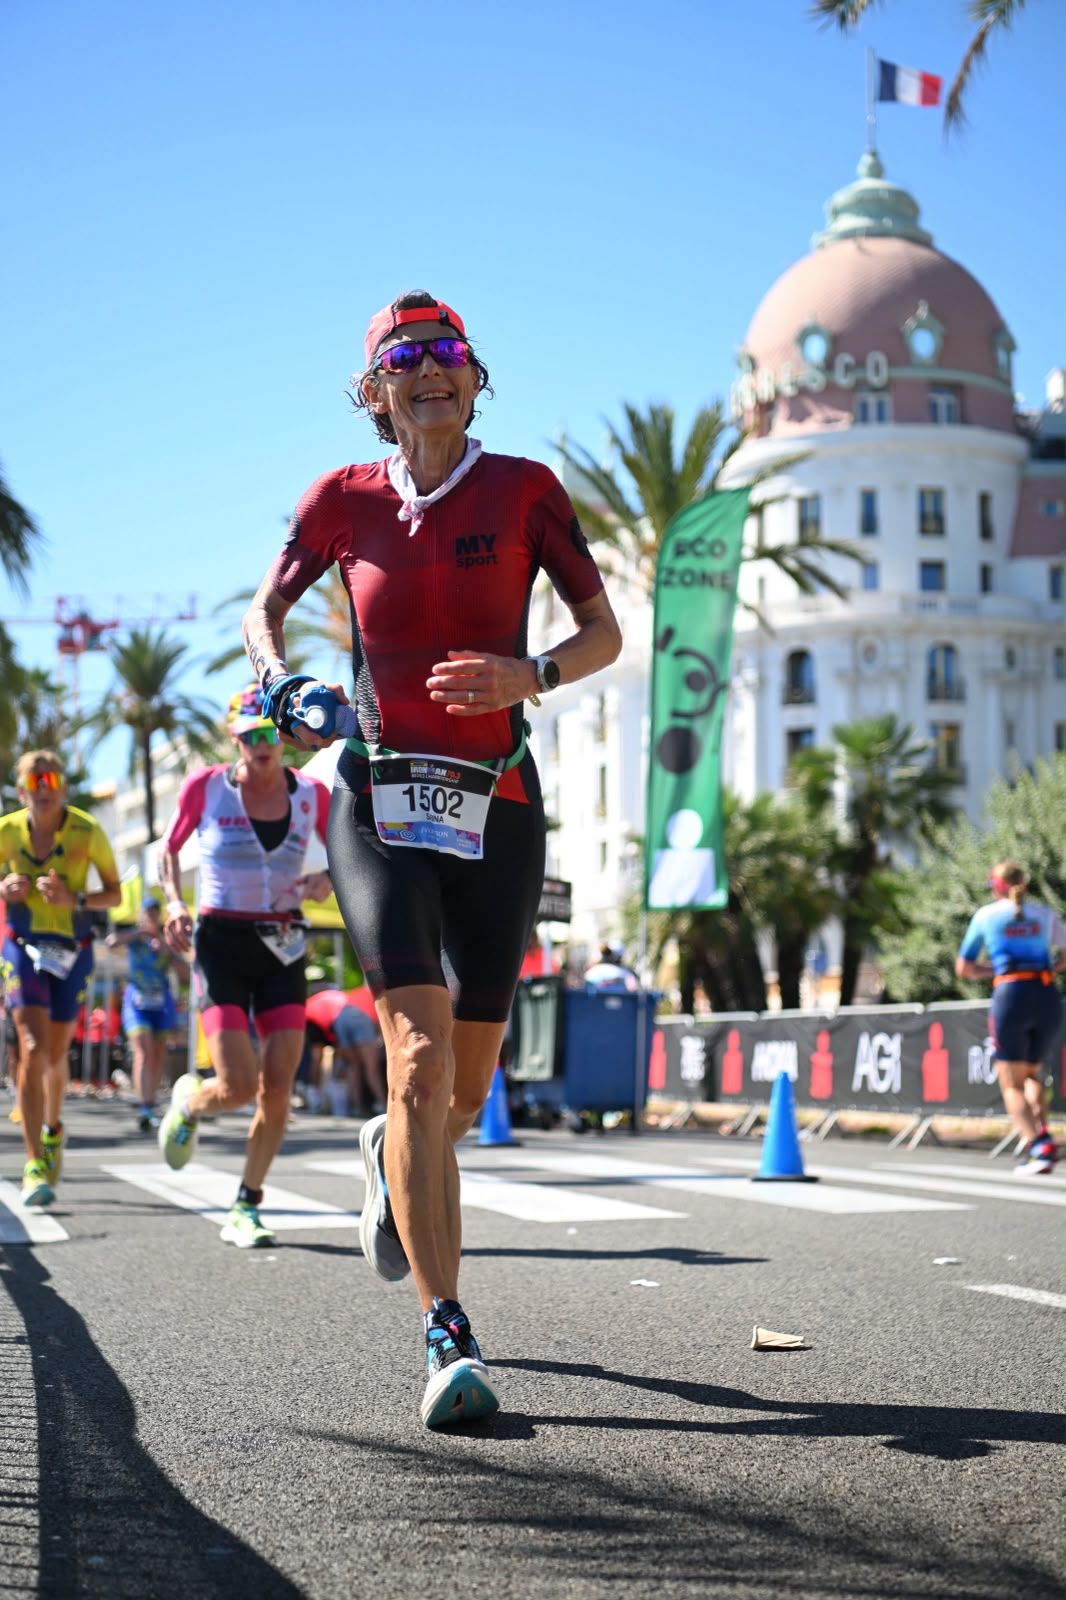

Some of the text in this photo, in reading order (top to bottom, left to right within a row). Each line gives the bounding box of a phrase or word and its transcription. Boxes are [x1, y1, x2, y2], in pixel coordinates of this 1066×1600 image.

[456, 534, 497, 555] MY
[675, 537, 727, 560] ECO
[456, 553, 498, 569] sport
[402, 785, 464, 819] 1502
